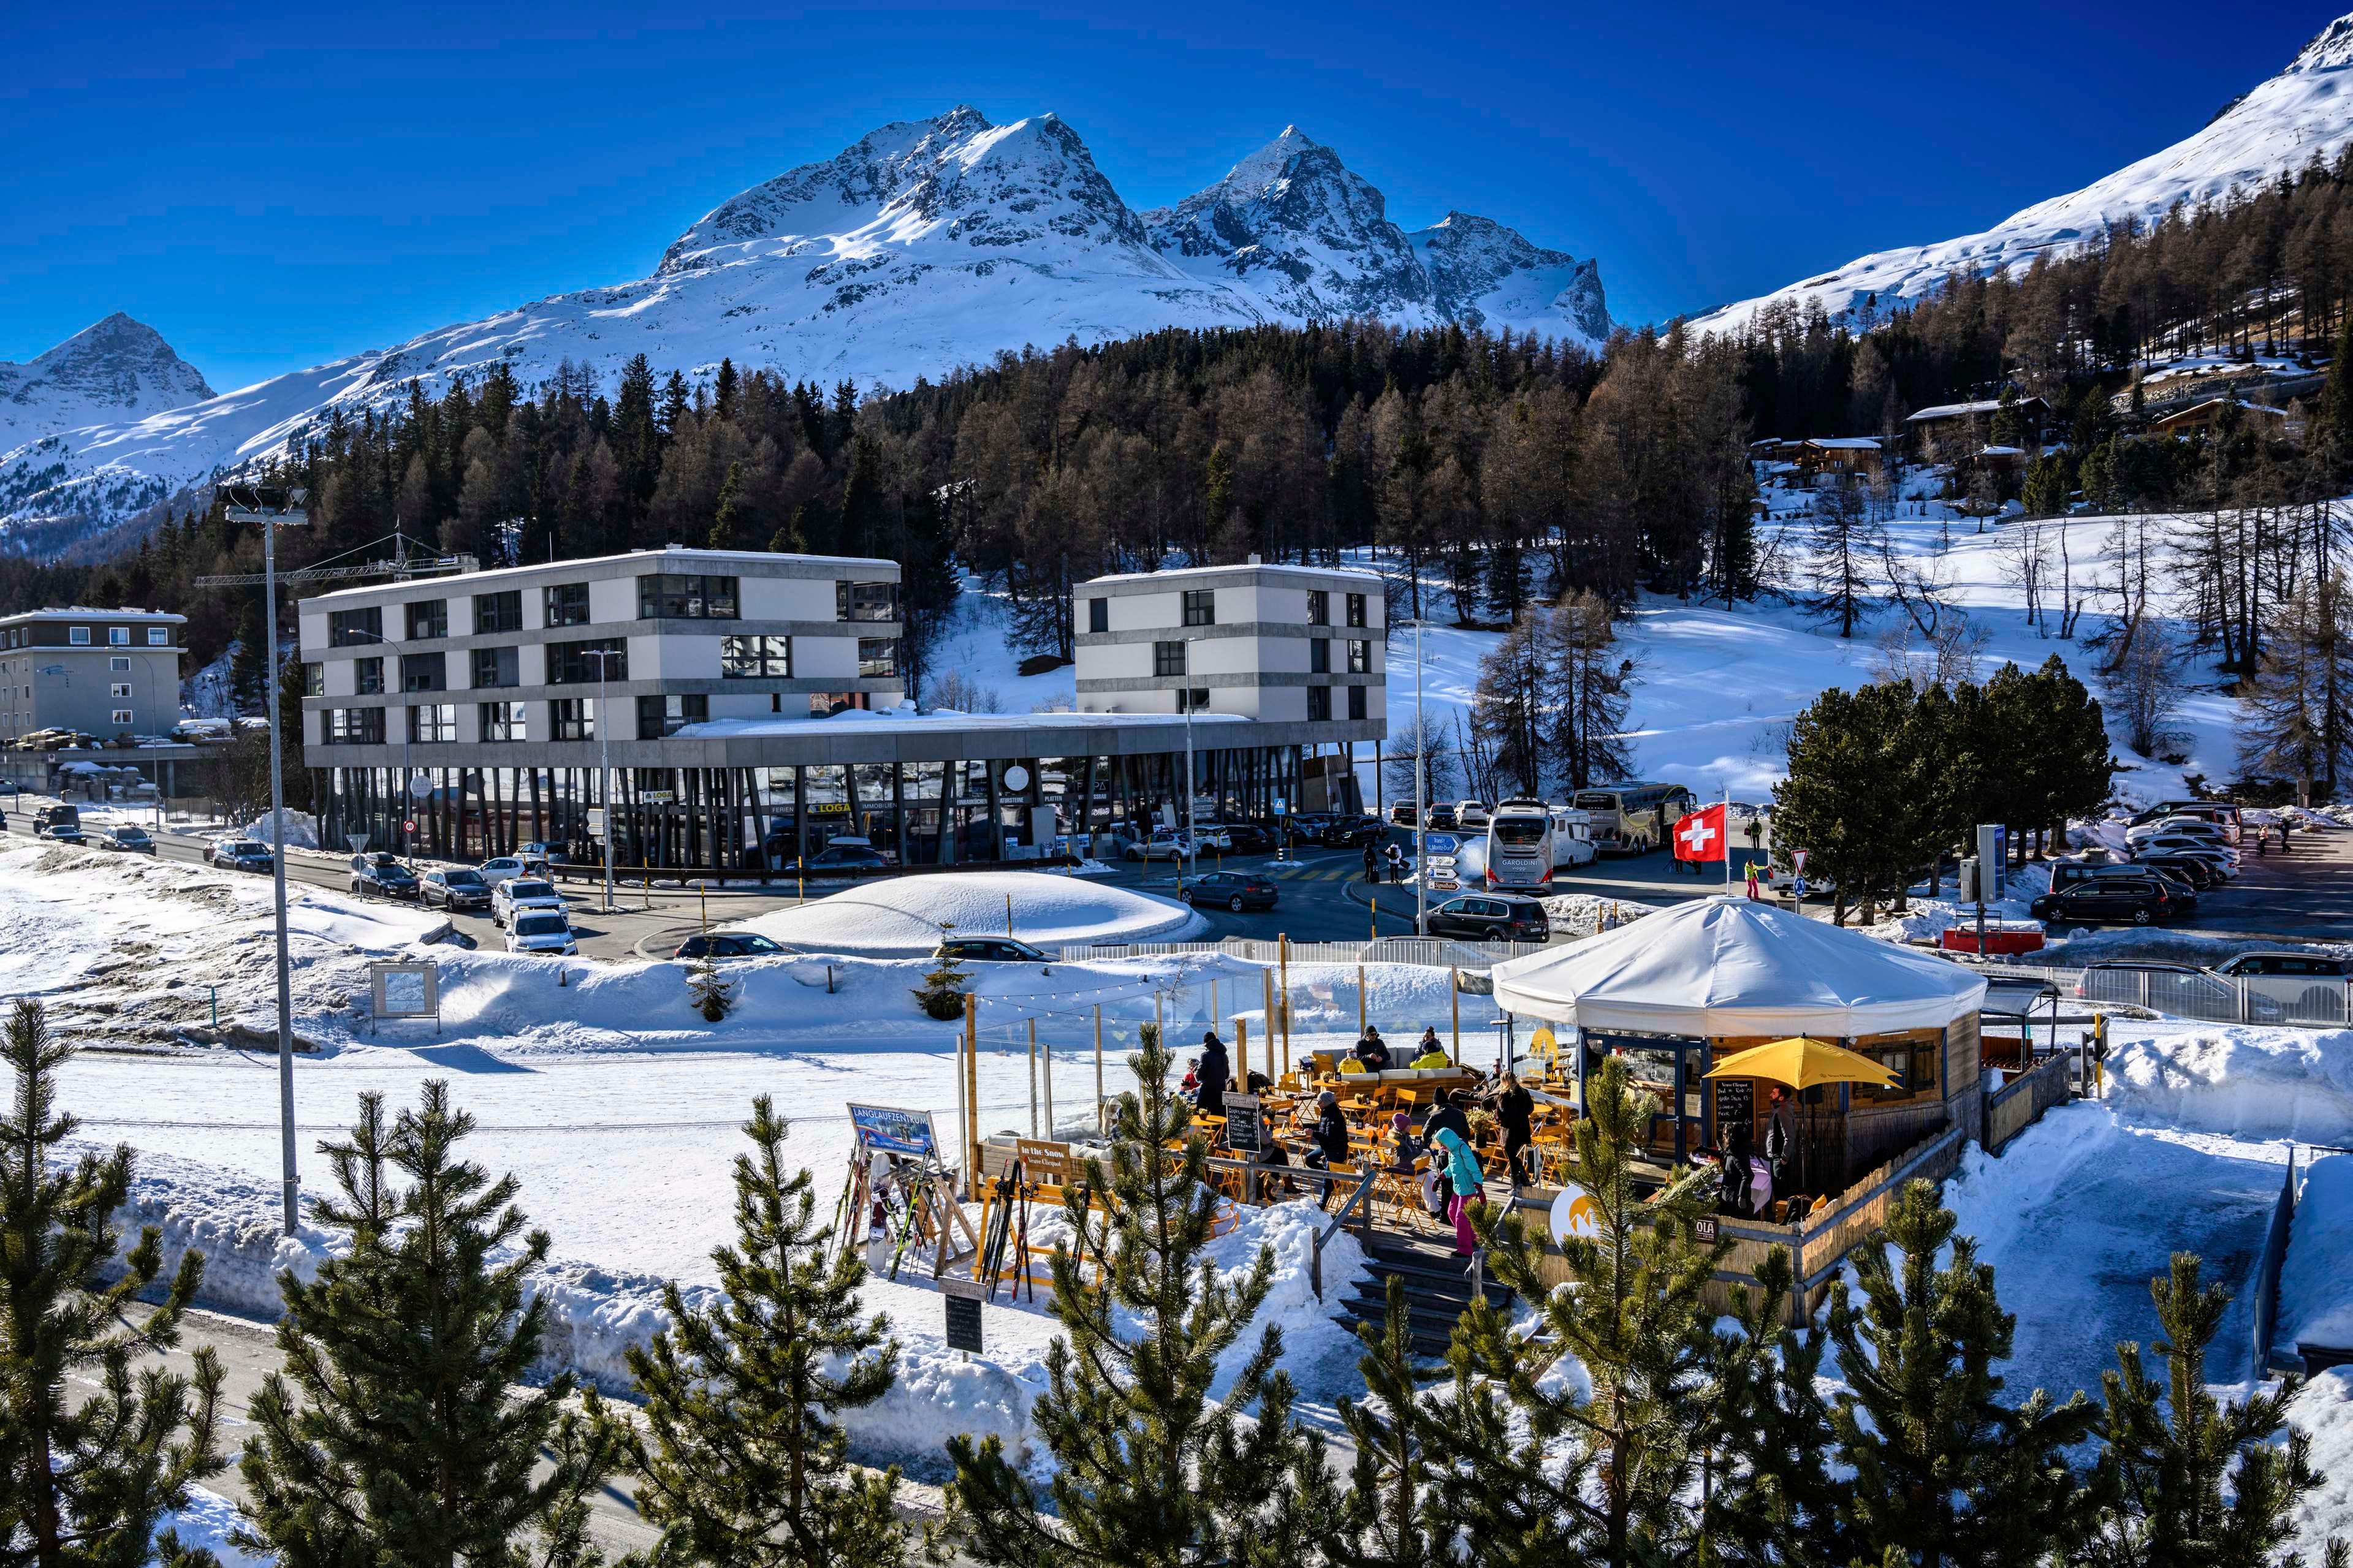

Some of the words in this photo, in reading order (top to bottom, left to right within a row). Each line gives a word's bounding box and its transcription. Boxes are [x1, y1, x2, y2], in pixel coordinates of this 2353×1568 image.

[820, 803, 851, 812] LOGA
[853, 1108, 928, 1125] LANGLAUFZENTRUM
[1030, 1147, 1043, 1156] the
[1044, 1149, 1065, 1158] Snow
[1042, 1158, 1061, 1167] Clicquot
[1696, 1221, 1714, 1233] OLA
